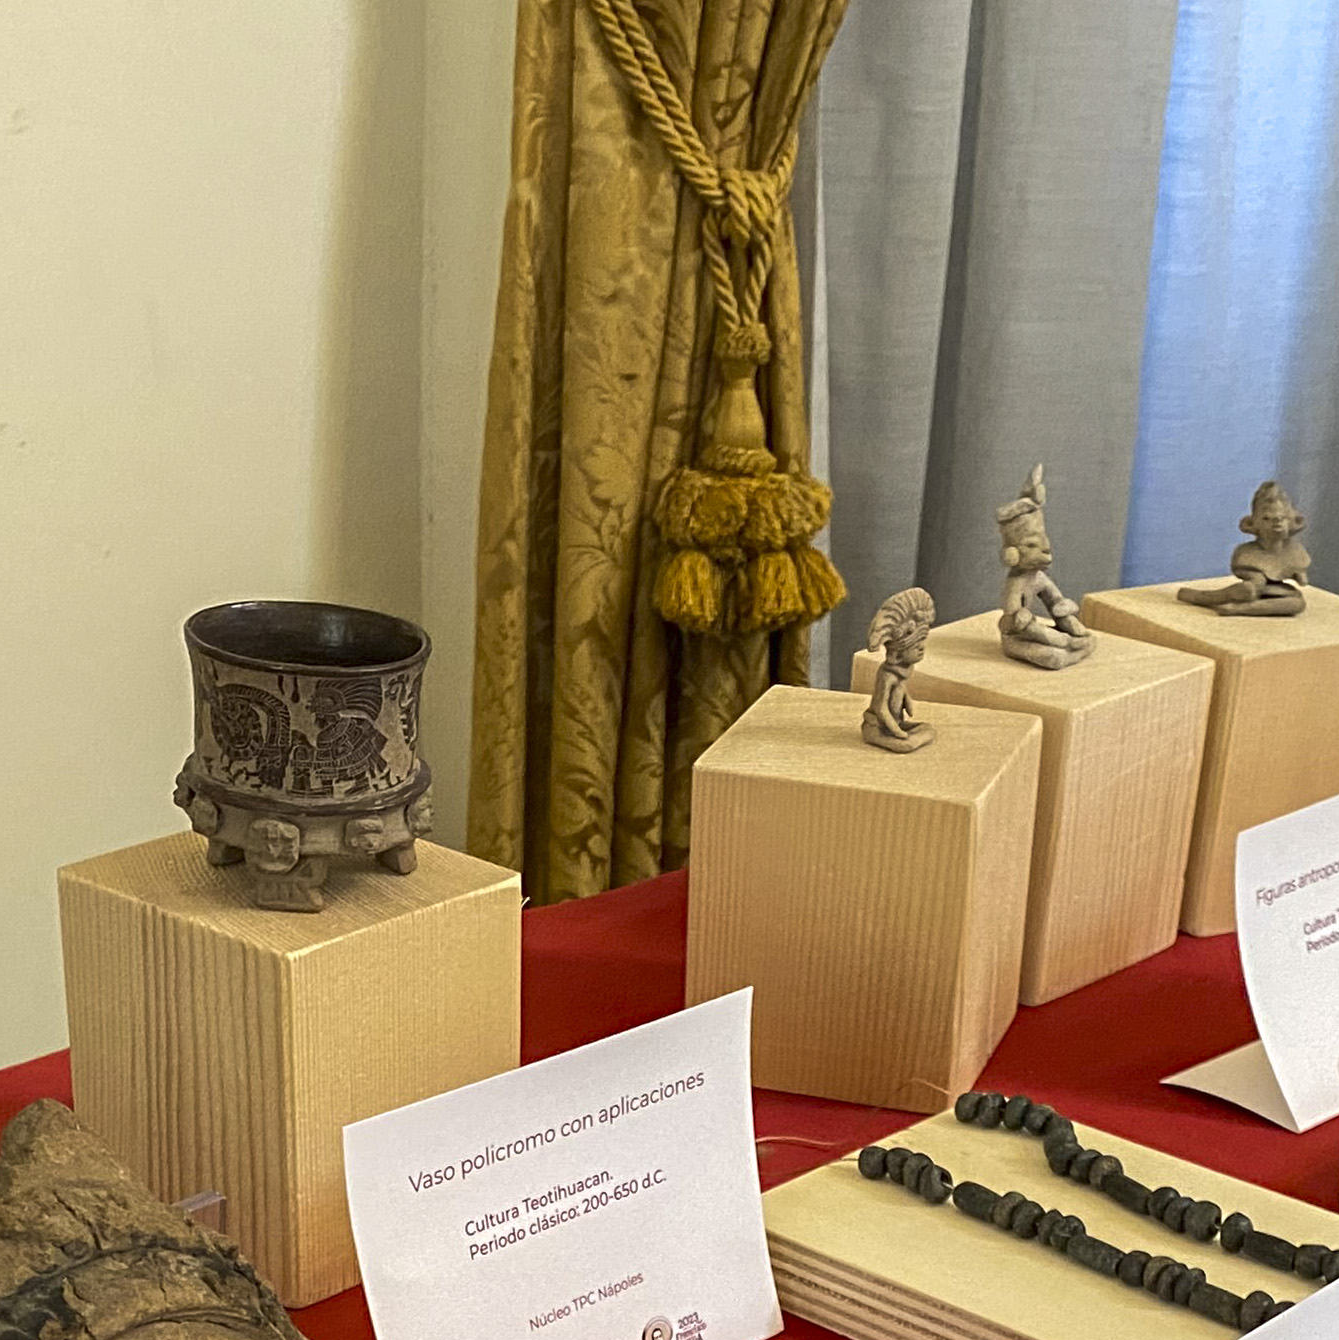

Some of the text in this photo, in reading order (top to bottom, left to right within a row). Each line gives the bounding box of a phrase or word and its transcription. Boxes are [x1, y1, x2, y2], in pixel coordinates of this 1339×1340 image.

[408, 1072, 705, 1193] Vaso policromo con aplicaciones
[465, 1171, 614, 1237] Cultura Teotihuacan.
[469, 1169, 667, 1261] Periodo clásico: 200-650 d.C.
[529, 1273, 645, 1332] Núcleo TPC Nápoles
